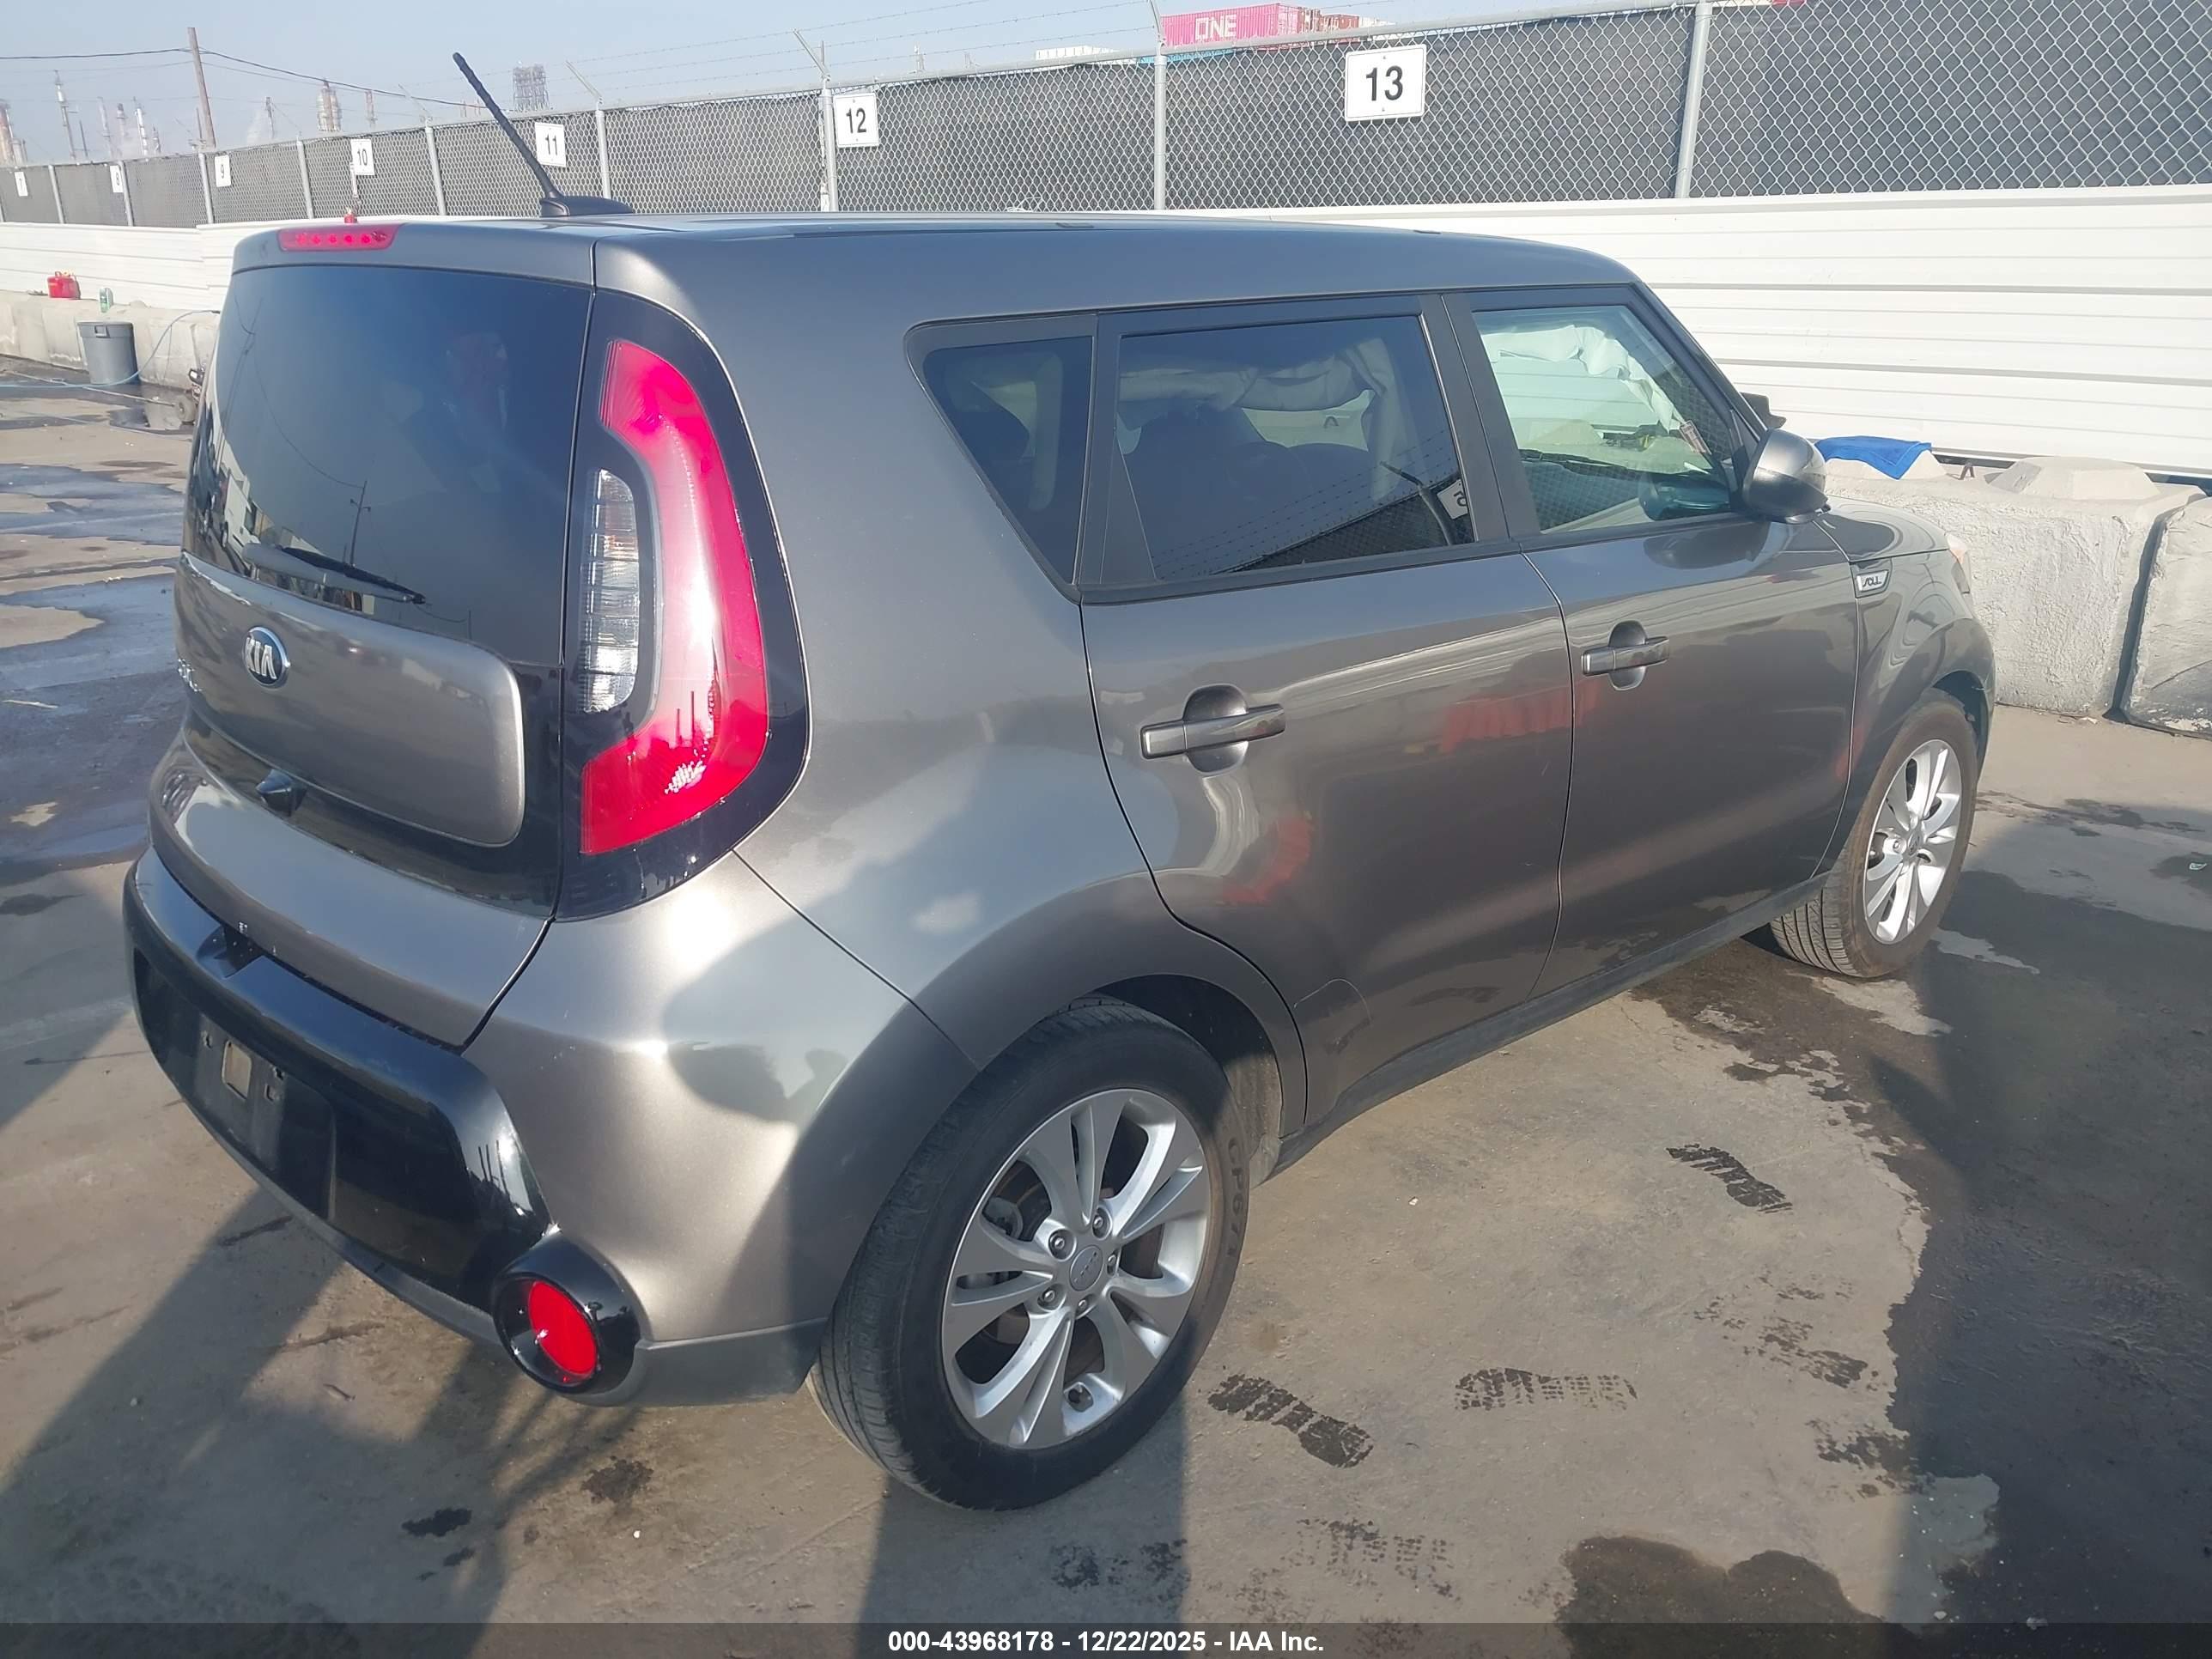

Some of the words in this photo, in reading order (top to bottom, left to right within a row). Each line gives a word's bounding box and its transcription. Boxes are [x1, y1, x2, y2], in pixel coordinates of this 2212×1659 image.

[1194, 14, 1237, 41] ONE
[1364, 64, 1404, 101] 13
[846, 107, 867, 134] 12
[356, 148, 368, 166] 10
[544, 133, 558, 156] 11
[220, 163, 225, 179] 9
[244, 636, 277, 680] KIA
